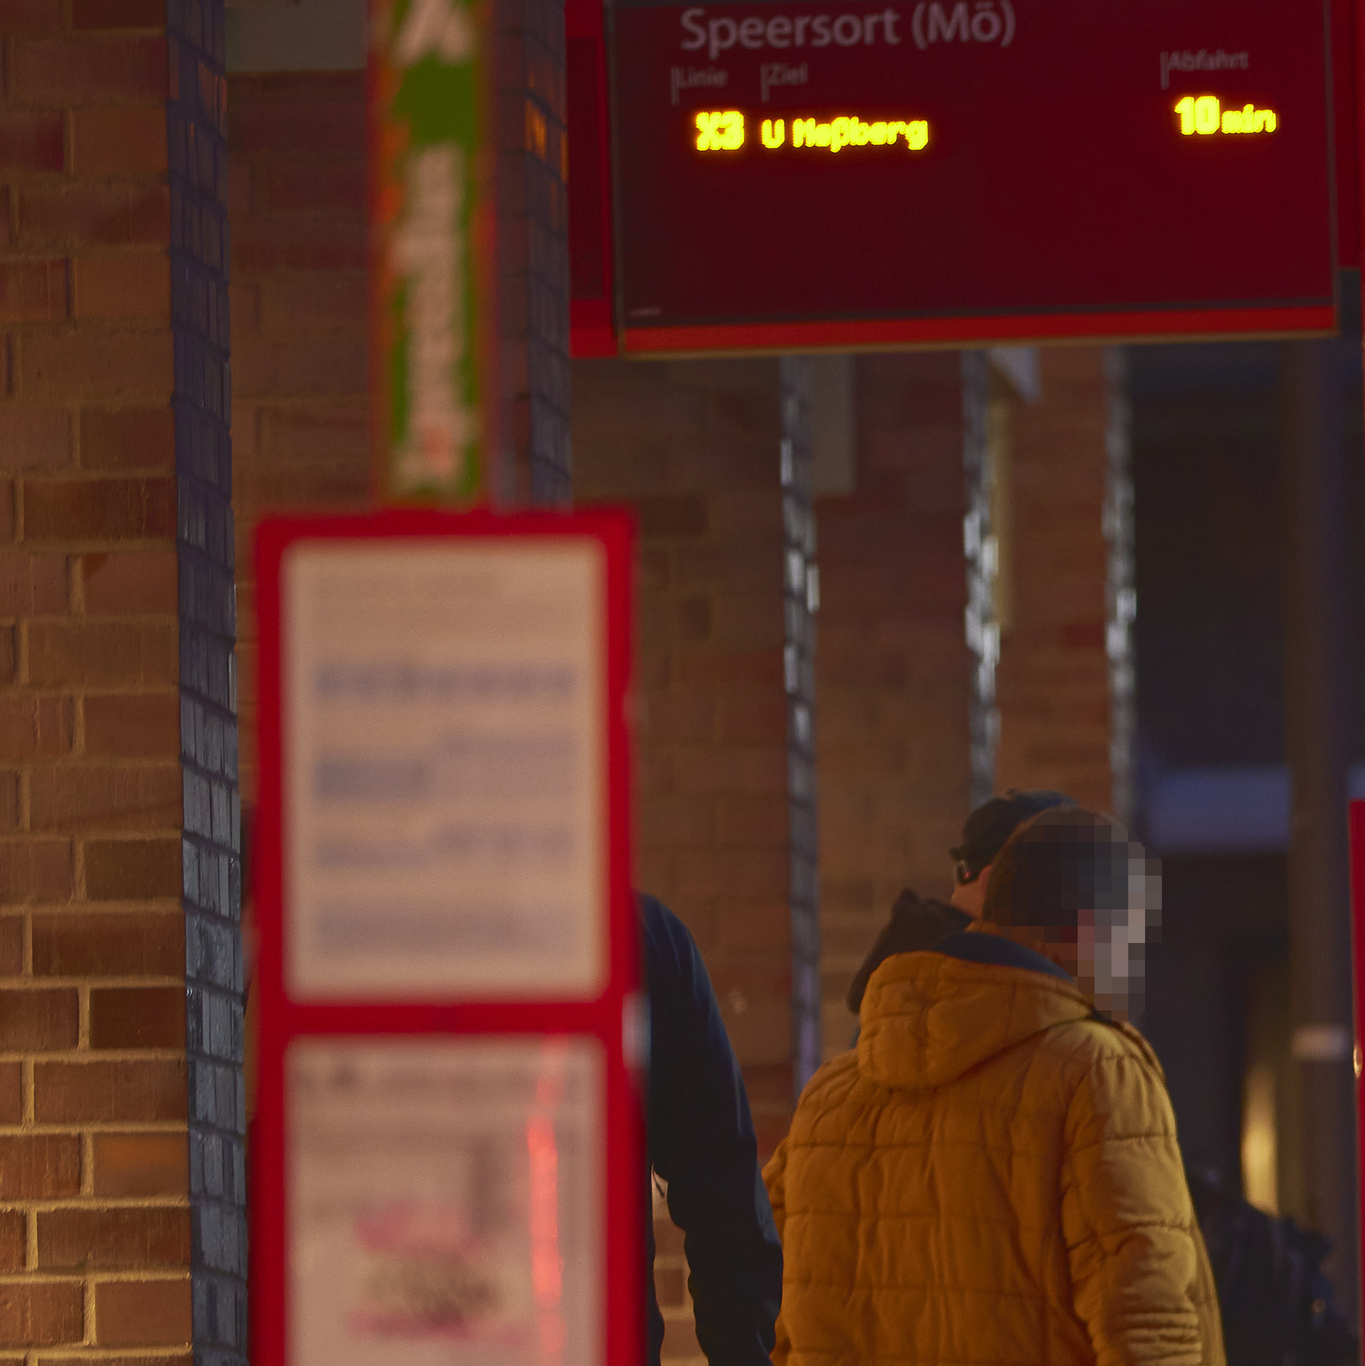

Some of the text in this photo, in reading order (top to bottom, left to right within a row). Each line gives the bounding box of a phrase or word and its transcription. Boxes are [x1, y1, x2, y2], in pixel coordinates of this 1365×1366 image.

[680, 0, 1017, 60] Speersort (Mö)
[1168, 48, 1250, 72] Abfahrt
[695, 110, 745, 152] X3
[760, 117, 786, 149] U
